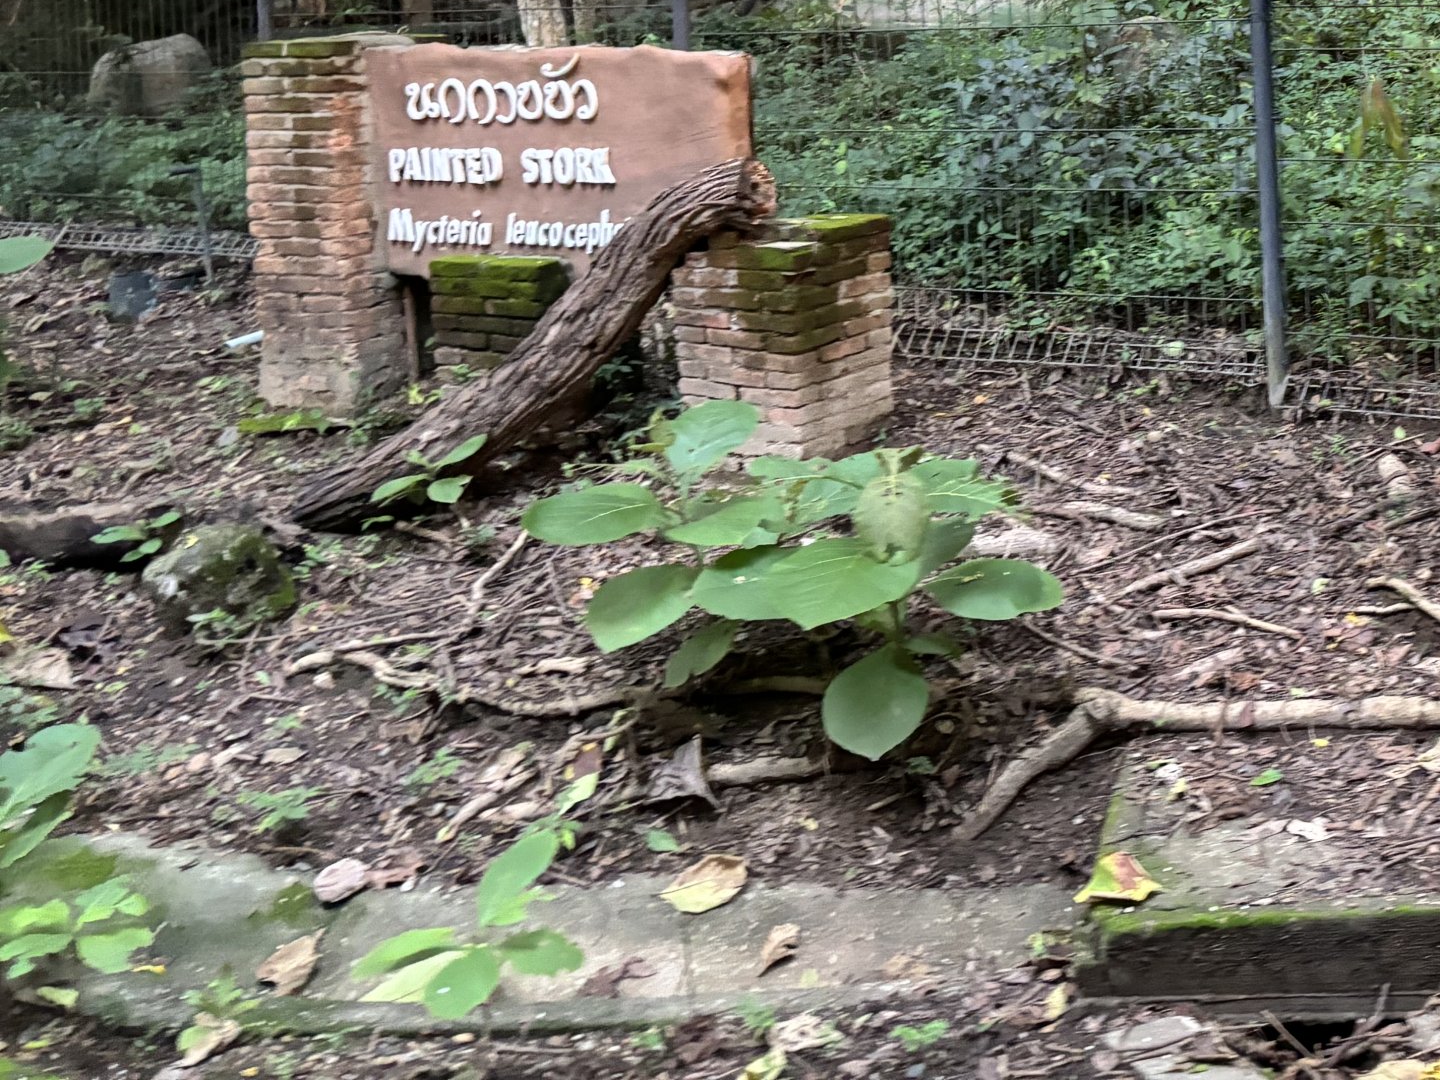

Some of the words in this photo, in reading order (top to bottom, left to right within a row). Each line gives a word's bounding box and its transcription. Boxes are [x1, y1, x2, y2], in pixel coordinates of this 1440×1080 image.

[388, 147, 503, 184] PAINTED
[520, 147, 616, 184] STORK
[387, 208, 492, 253] Mycteria
[505, 209, 632, 255] leucoceph
